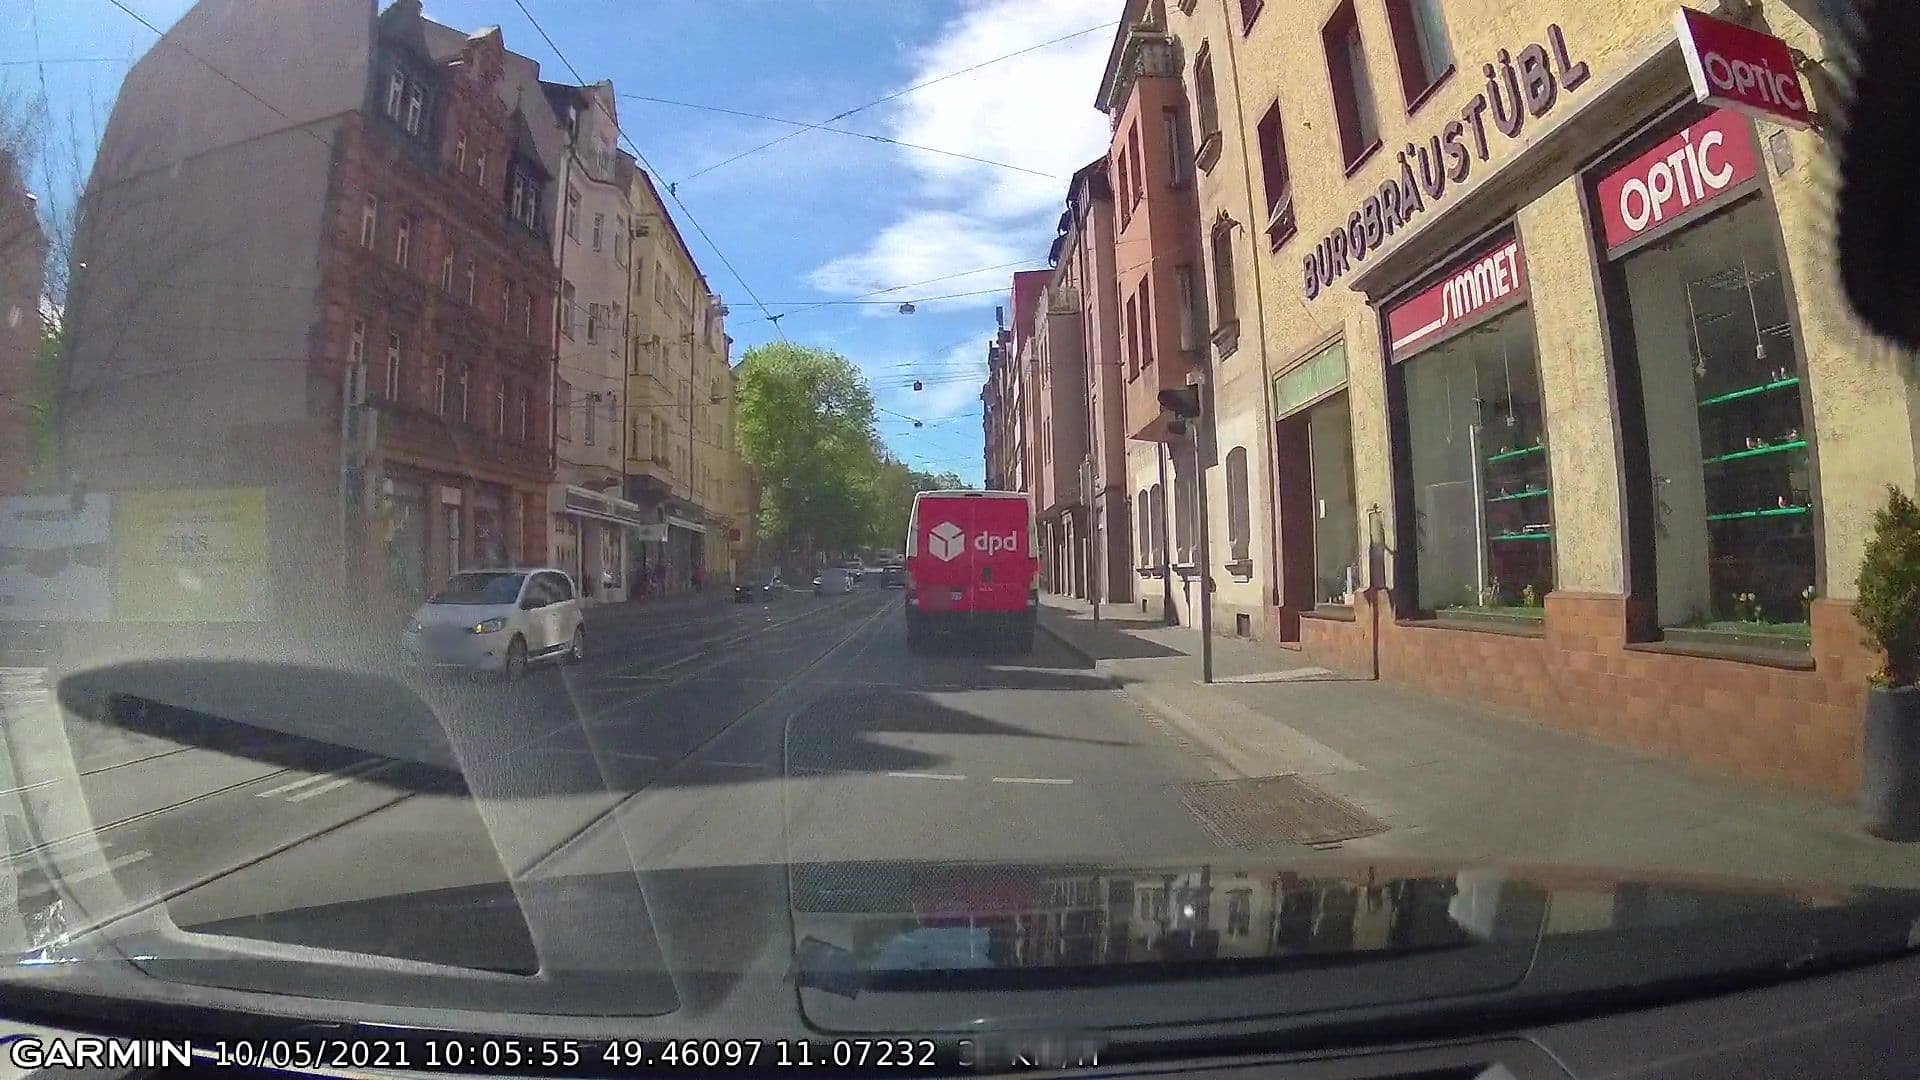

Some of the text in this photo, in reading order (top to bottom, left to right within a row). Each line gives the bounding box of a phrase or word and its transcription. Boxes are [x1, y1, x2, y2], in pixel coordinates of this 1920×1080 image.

[1302, 23, 1591, 300] BURGBRÄUSTÜBL
[1440, 242, 1519, 326] SIMMET
[974, 530, 1018, 556] dpd
